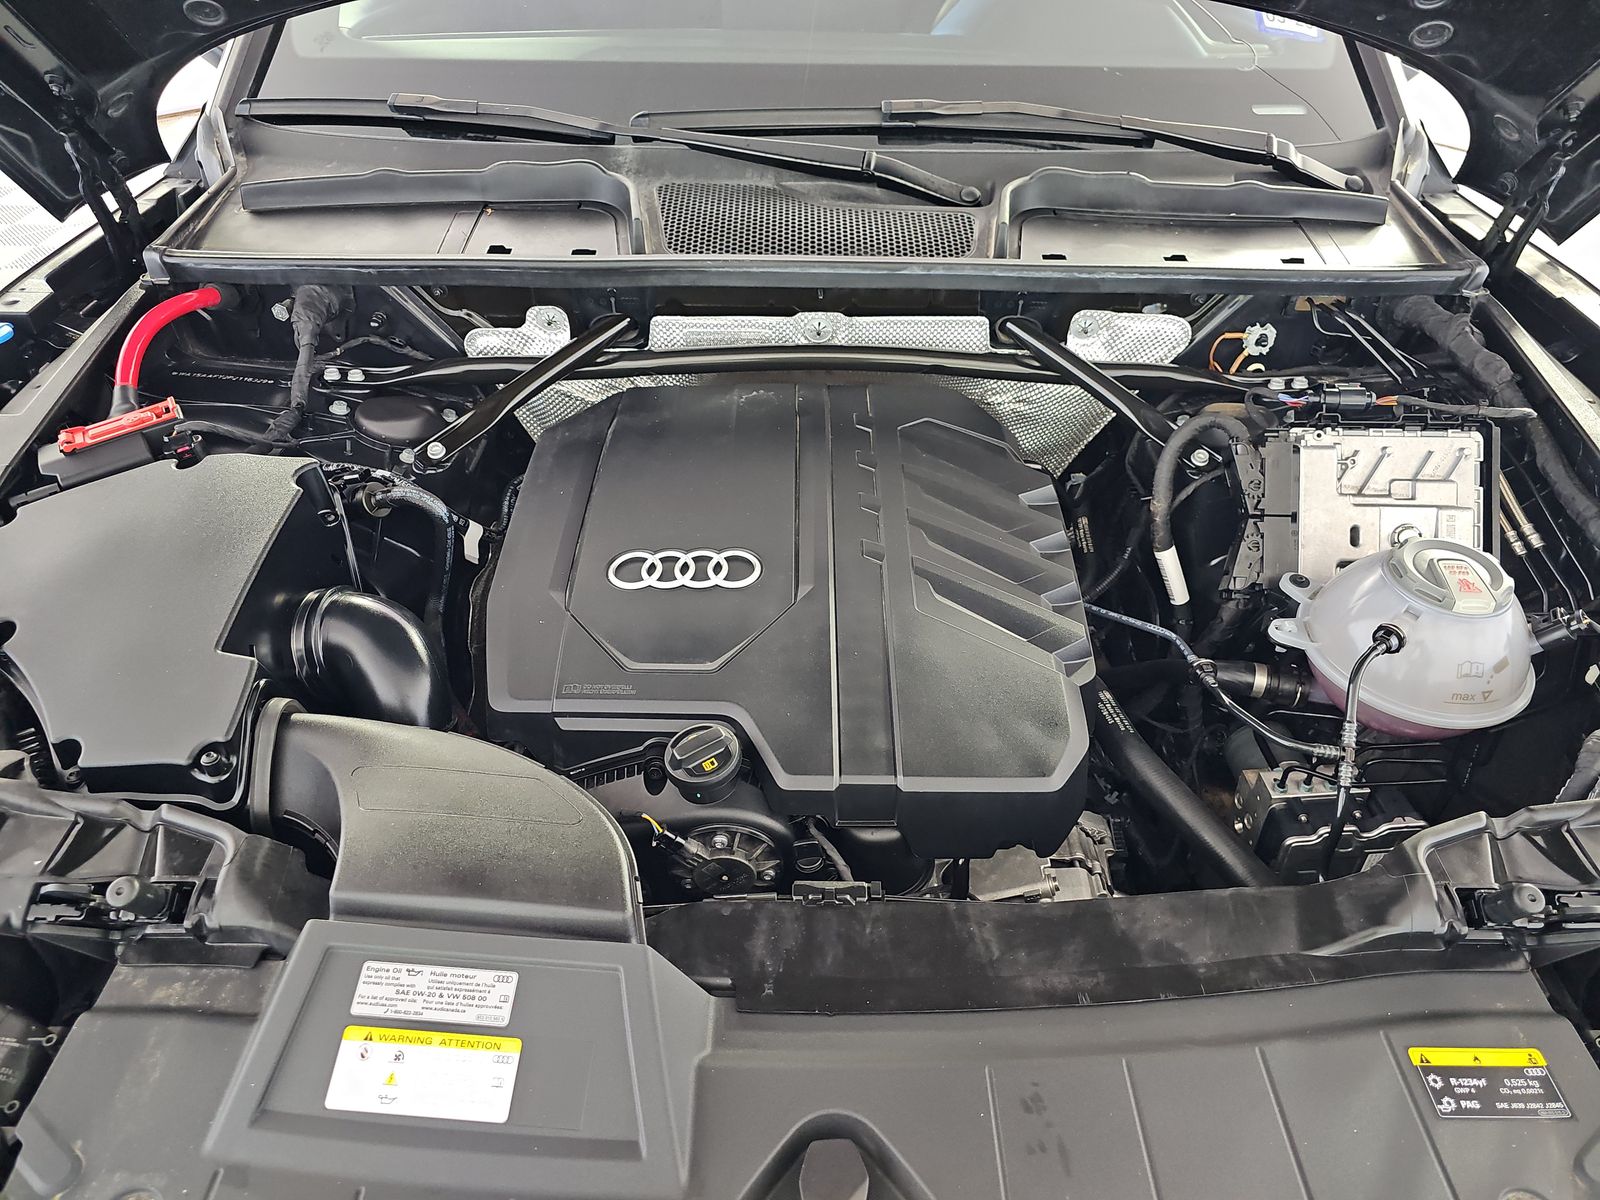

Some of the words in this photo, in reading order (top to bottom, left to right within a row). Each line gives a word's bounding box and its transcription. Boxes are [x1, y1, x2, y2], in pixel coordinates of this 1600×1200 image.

[1452, 692, 1476, 700] max
[379, 1034, 432, 1045] WARNING
[439, 1038, 502, 1050] ATTENTION
[1450, 1078, 1487, 1088] R-1234yf
[1504, 1079, 1526, 1087] 0,525
[1528, 1079, 1540, 1088] kg
[1460, 1100, 1480, 1109] PAG
